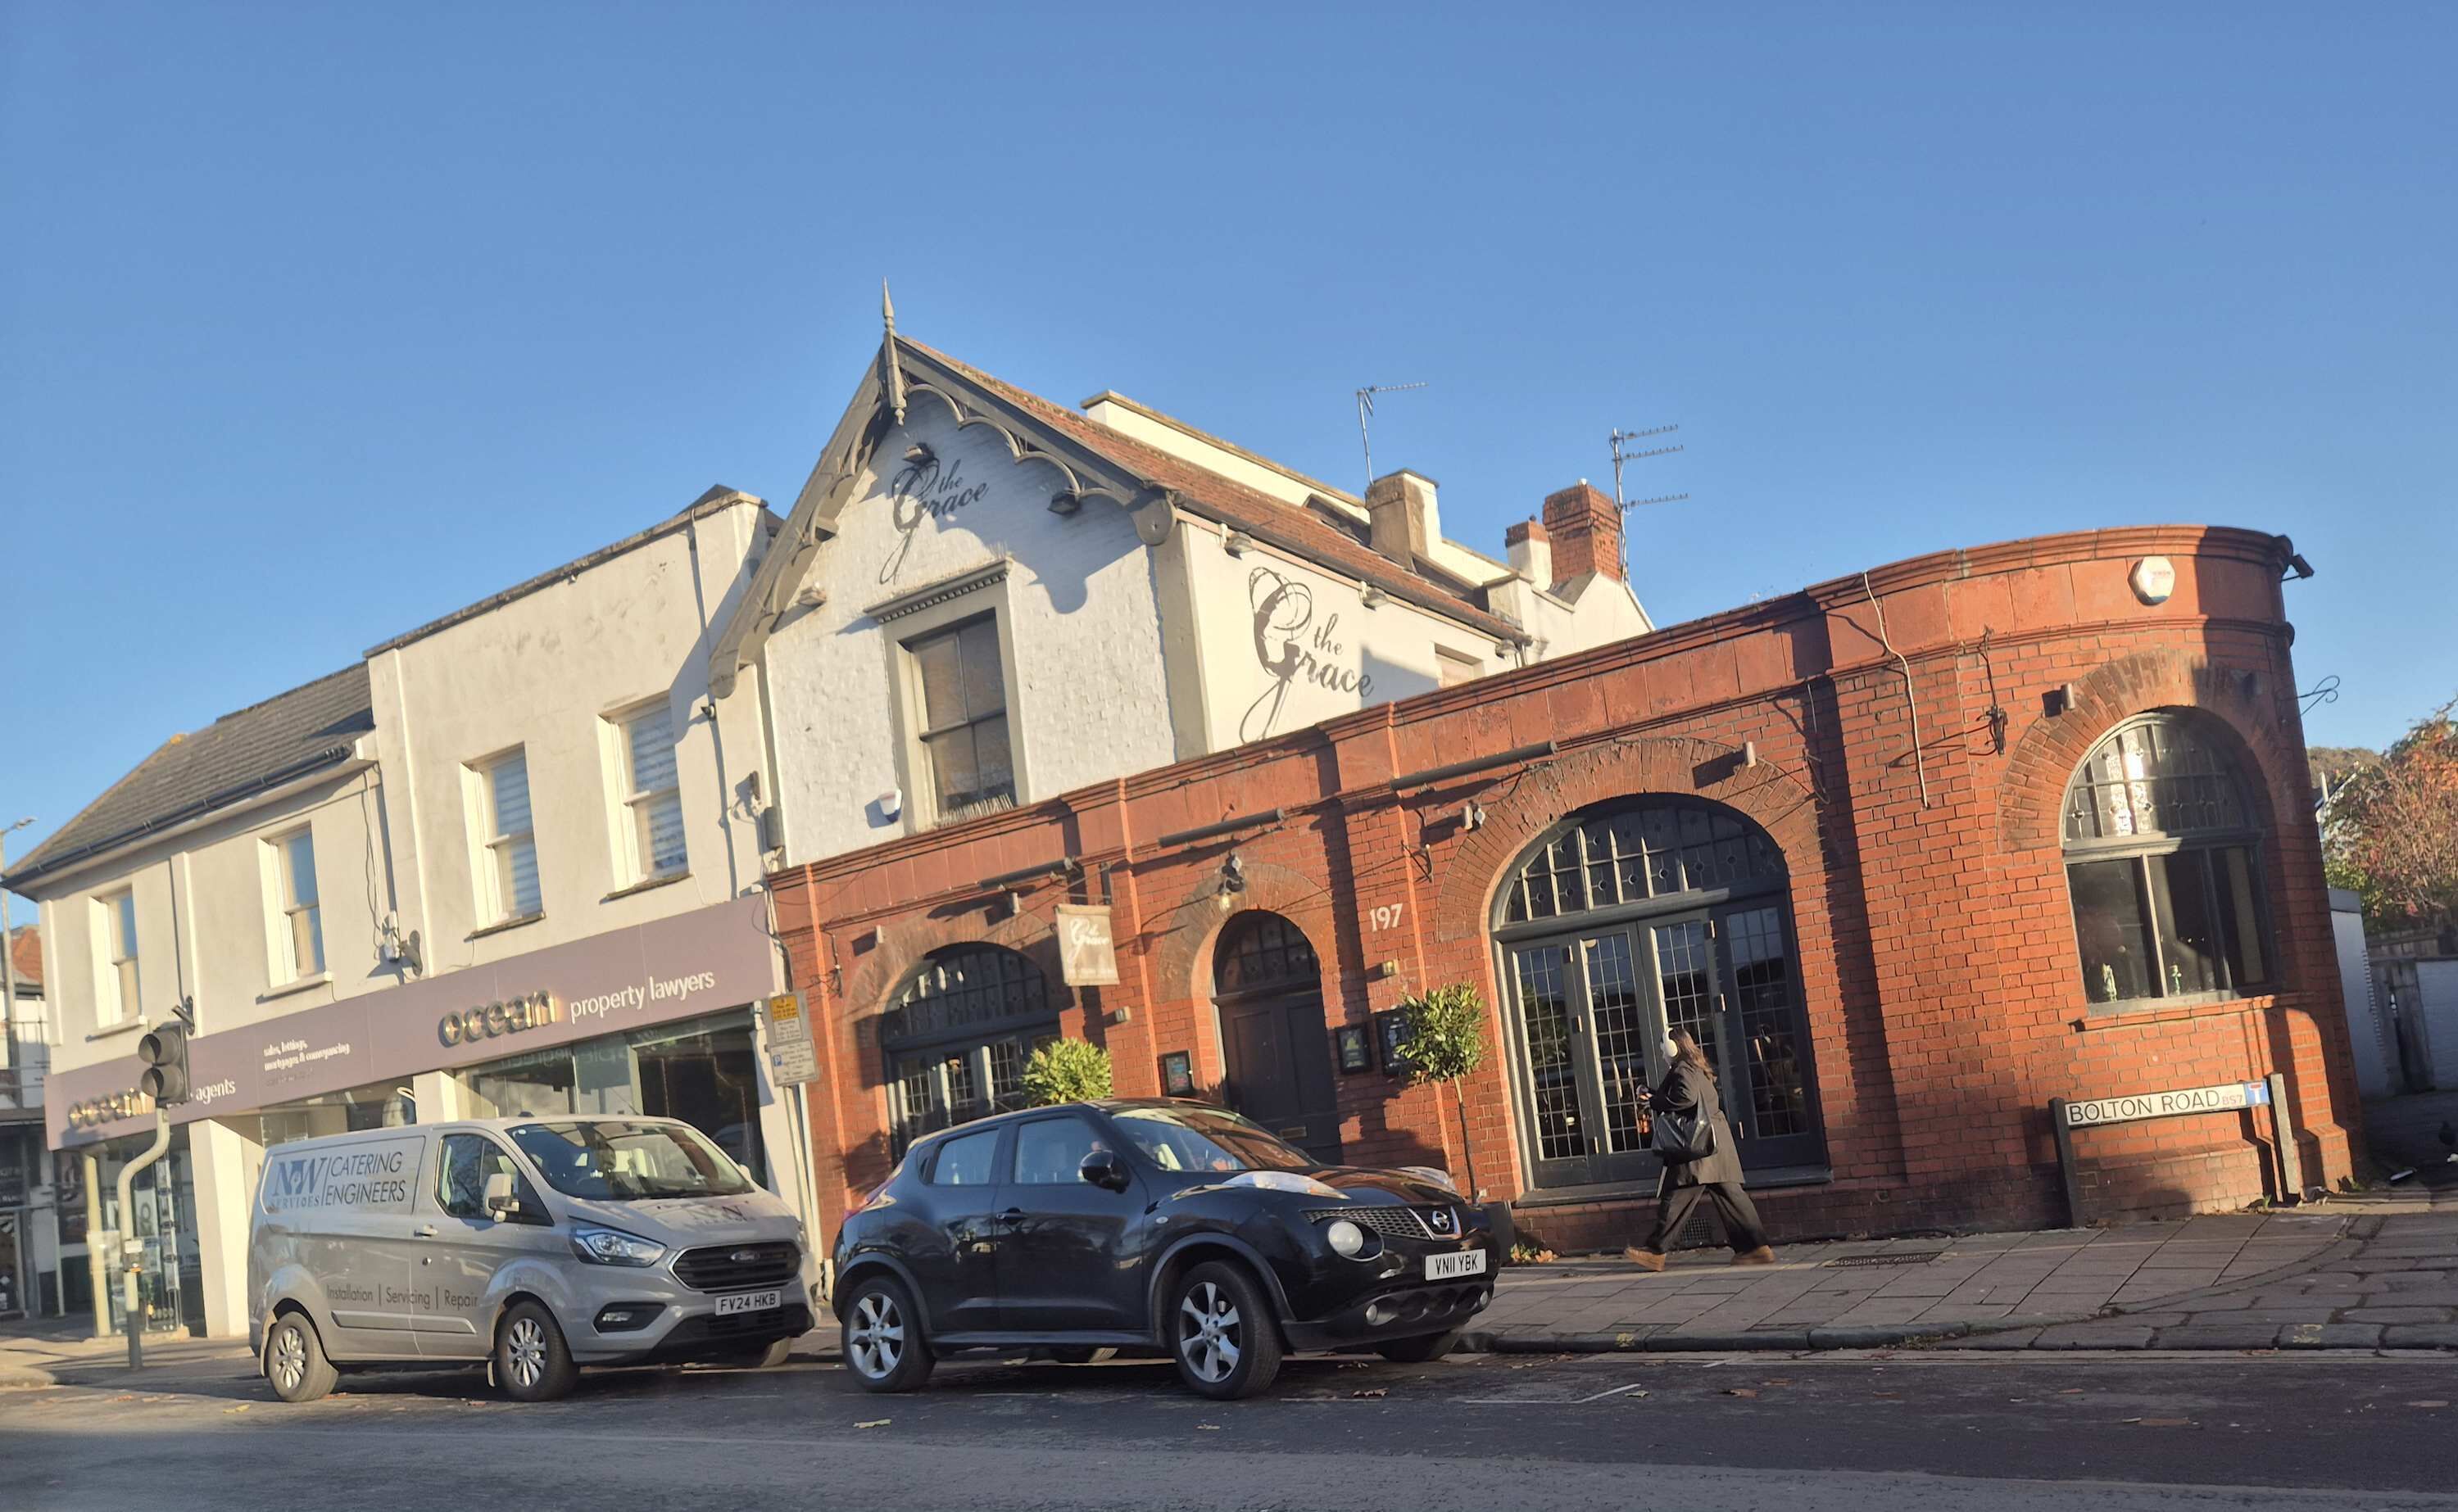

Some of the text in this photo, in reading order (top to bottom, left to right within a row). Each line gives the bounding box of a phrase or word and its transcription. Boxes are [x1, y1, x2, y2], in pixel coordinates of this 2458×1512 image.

[938, 459, 964, 493] the
[879, 458, 990, 586] Grace
[1313, 613, 1344, 656] the
[1239, 566, 1375, 745] Grace
[1370, 903, 1403, 932] 197
[438, 971, 715, 1048] ocean property lawyers
[69, 1085, 156, 1129] ocean
[196, 1078, 237, 1105] agents
[2069, 1089, 2243, 1123] BOLTON ROAD BS7
[330, 1151, 403, 1177] CATERING
[326, 1179, 406, 1206] ENGINEERS
[1435, 1253, 1478, 1275] VN11 YBK
[327, 1284, 478, 1311] Installation Servicing Repair
[720, 1293, 777, 1311] FV24 HKB
